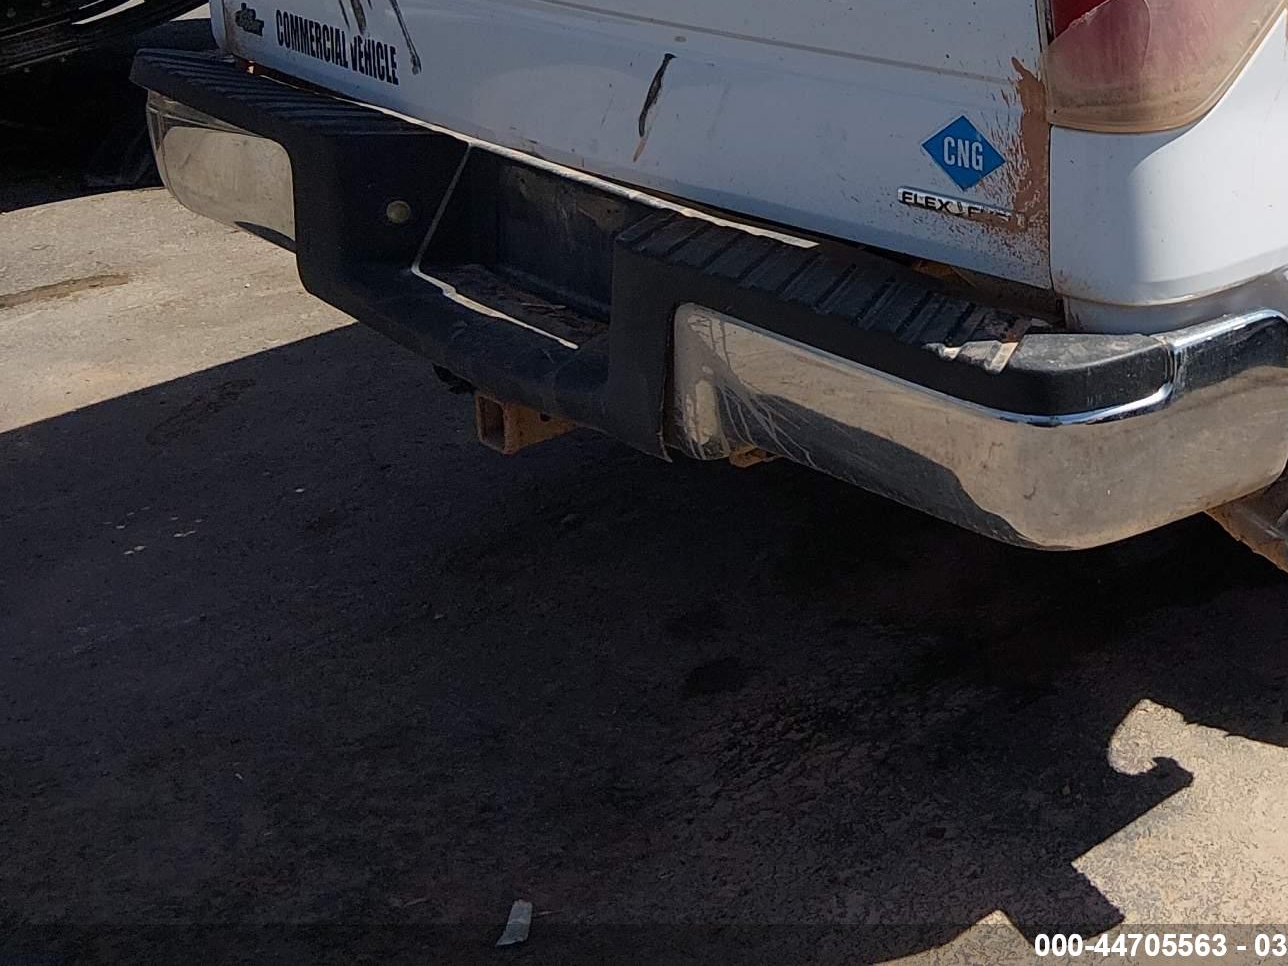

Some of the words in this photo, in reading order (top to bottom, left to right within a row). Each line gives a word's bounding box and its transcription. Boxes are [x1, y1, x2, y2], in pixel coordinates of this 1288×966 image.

[275, 9, 349, 69] COMMERCIAL
[350, 35, 398, 85] VEHICLE
[943, 137, 984, 170] CNG
[902, 191, 955, 214] FLEX
